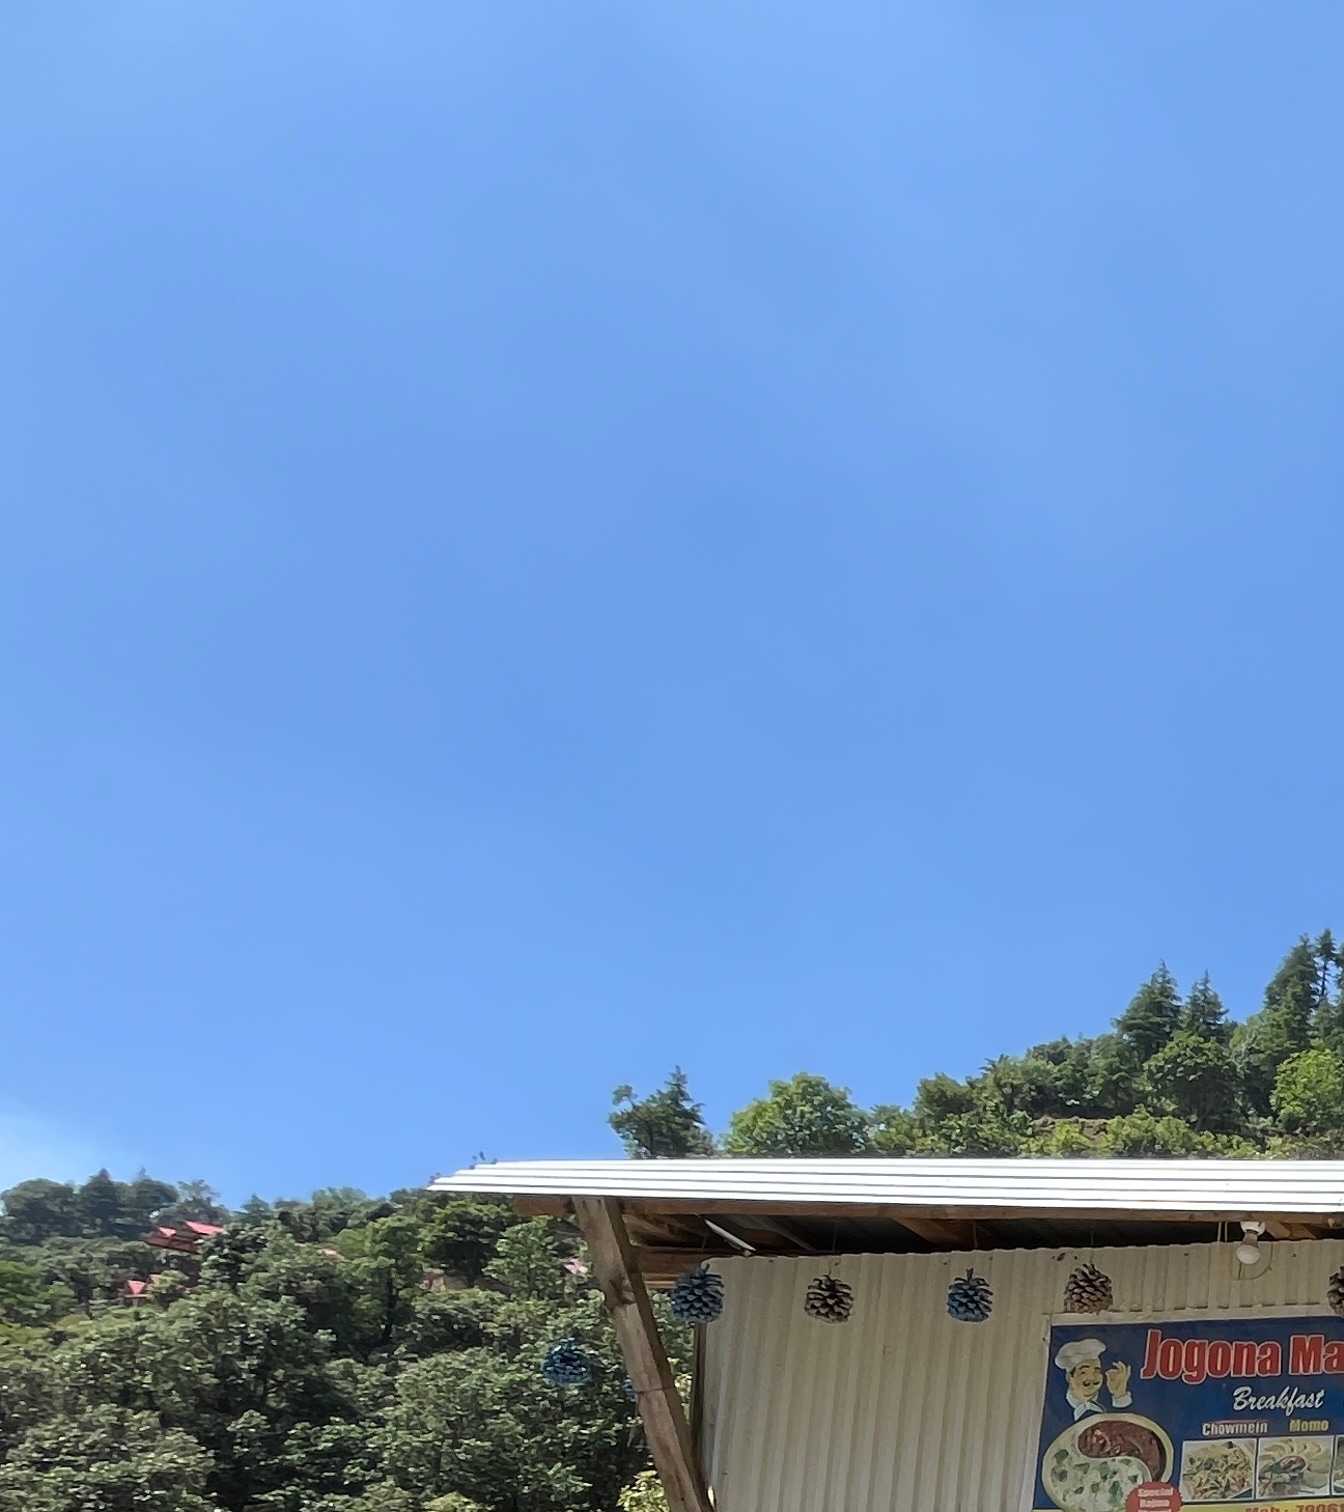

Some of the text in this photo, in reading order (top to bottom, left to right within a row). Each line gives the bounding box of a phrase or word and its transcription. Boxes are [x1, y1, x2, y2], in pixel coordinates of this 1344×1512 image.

[1140, 1329, 1282, 1384] Jogona
[1233, 1386, 1325, 1418] Breakfast
[1202, 1420, 1268, 1436] Chowmein
[1289, 1418, 1329, 1433] Momo
